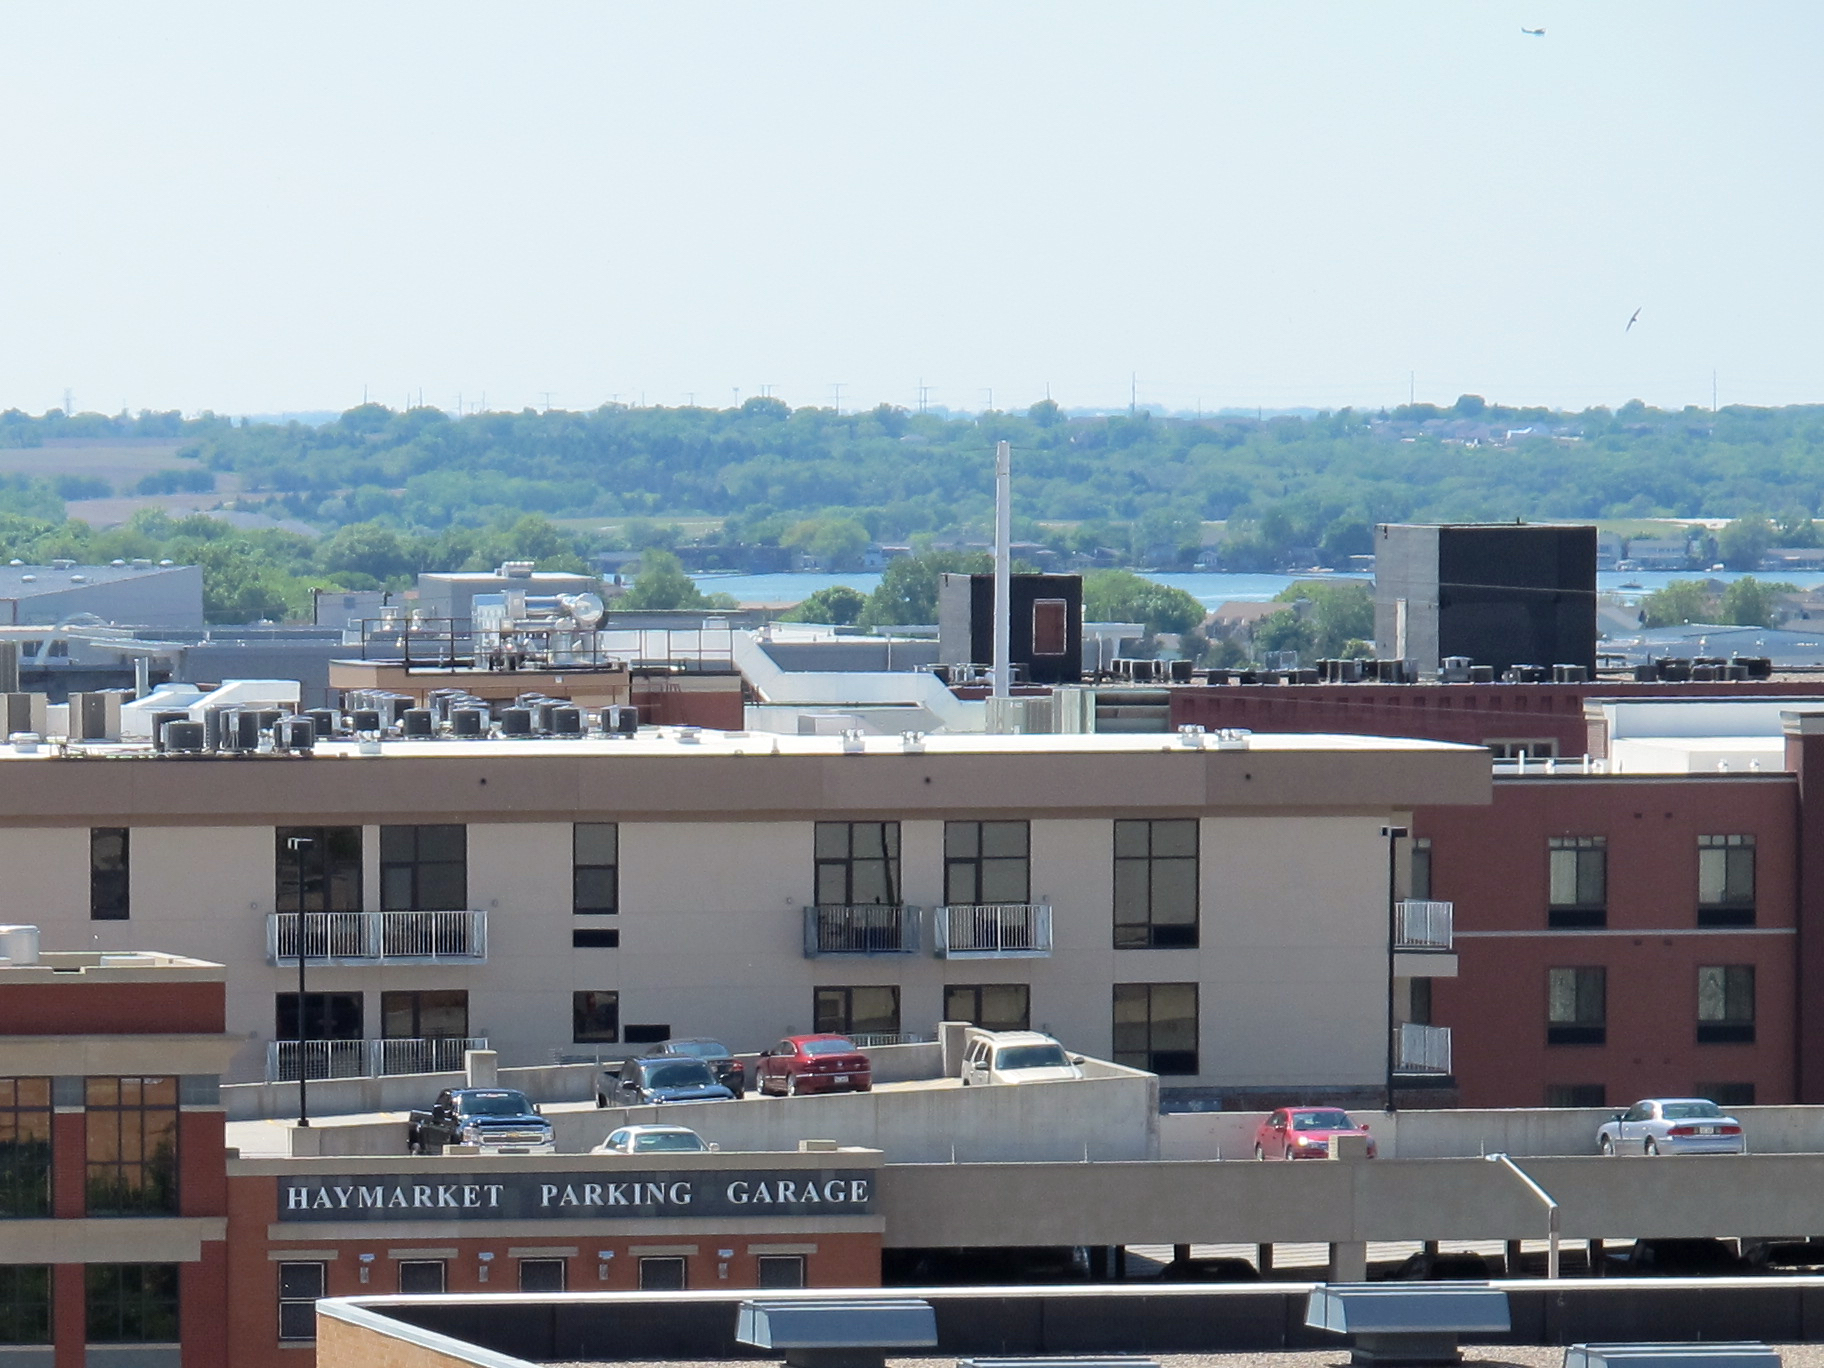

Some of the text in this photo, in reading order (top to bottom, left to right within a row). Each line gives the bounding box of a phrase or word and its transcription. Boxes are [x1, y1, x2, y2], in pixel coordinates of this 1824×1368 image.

[286, 1179, 870, 1209] HAYMARKET PARKING GARAGE
